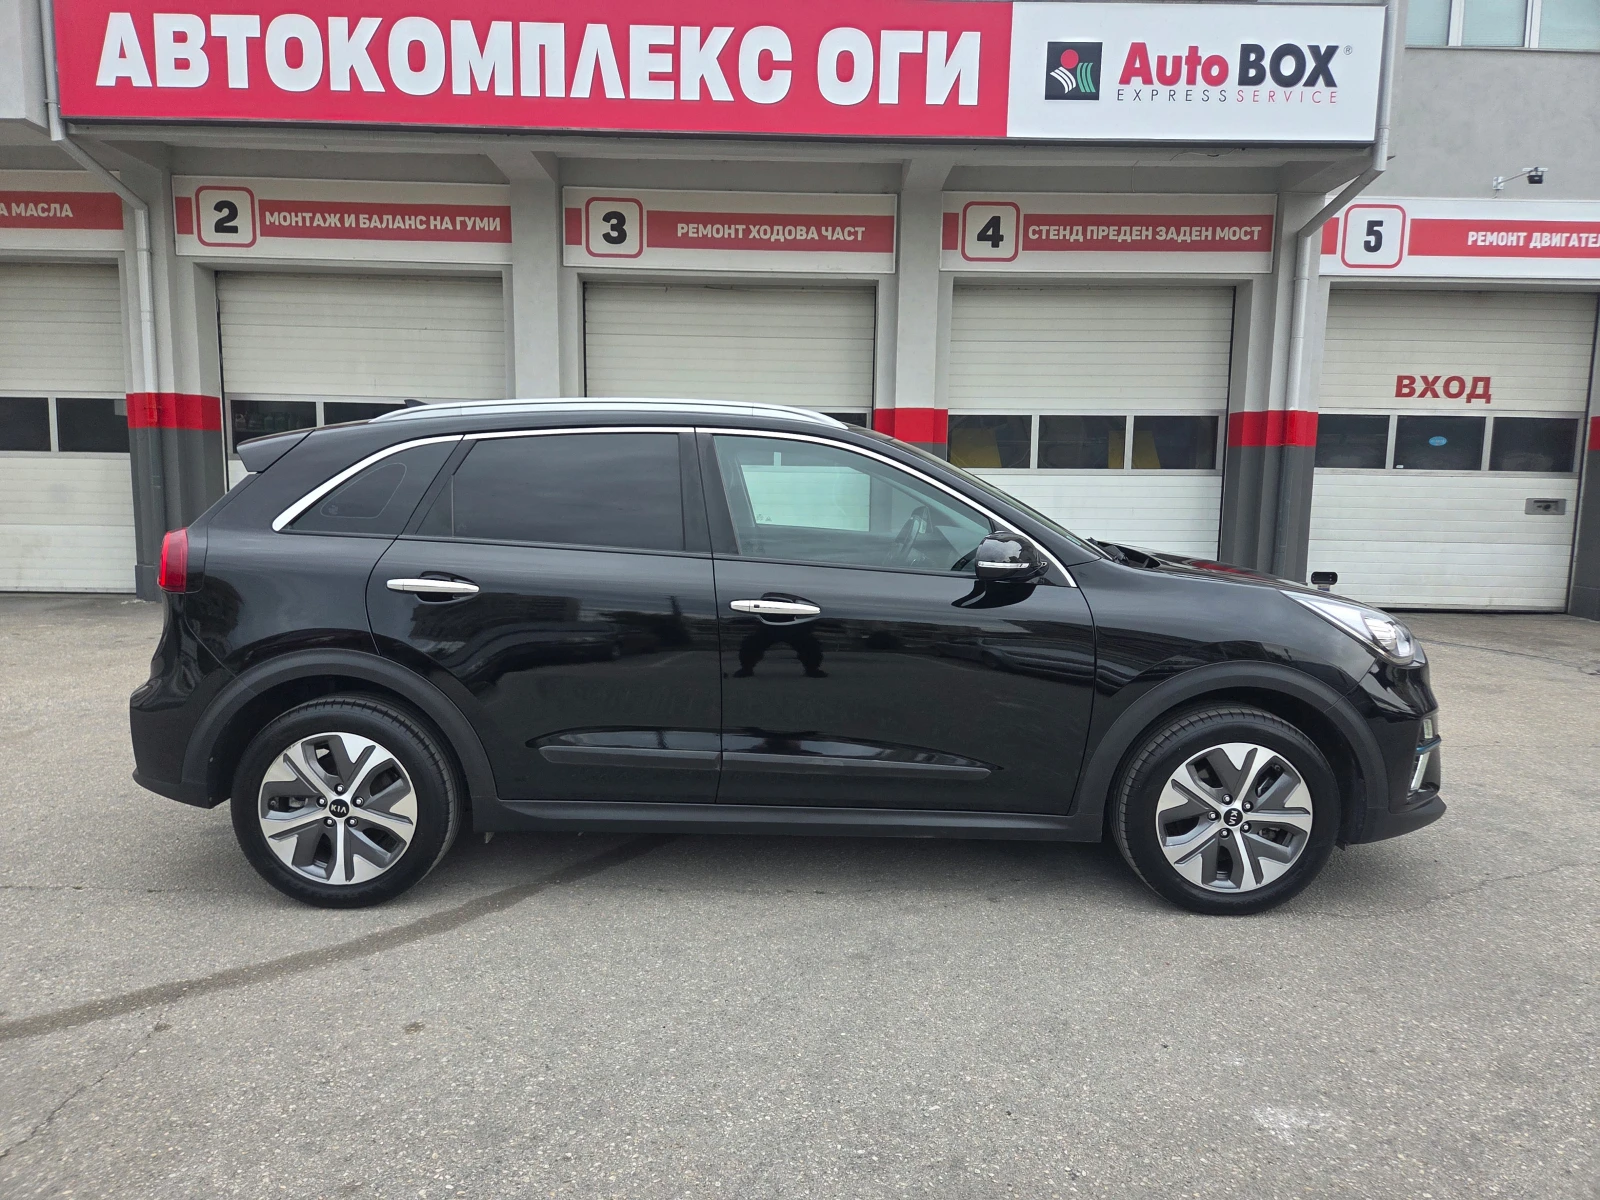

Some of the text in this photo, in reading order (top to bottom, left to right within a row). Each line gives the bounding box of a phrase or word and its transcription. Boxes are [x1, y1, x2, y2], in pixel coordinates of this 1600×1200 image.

[96, 12, 981, 106] АВТОКОМПЛЕКС ОГИ
[1118, 42, 1339, 88] Auto BOX
[1117, 89, 1337, 104] EXPRESS SERVICE
[11, 202, 73, 218] МАСЛА
[213, 200, 239, 234] 2
[265, 211, 501, 231] МОНТАЖ И БАЛАНС НА ГУМИ
[602, 211, 627, 245] 3
[677, 223, 865, 242] РЕМОНТ ХОДОВА ЧАСТ
[976, 215, 1004, 249] 4
[1028, 225, 1262, 242] СТЕНД ПРЕДЕН ЗАДЕН МОСТ
[1363, 219, 1384, 253] 5
[1467, 231, 1600, 249] РЕМОНТ ДВИГАТЕ
[1394, 375, 1492, 404] ВХОД
[330, 803, 347, 814] KIA
[1228, 810, 1238, 825] KIA
